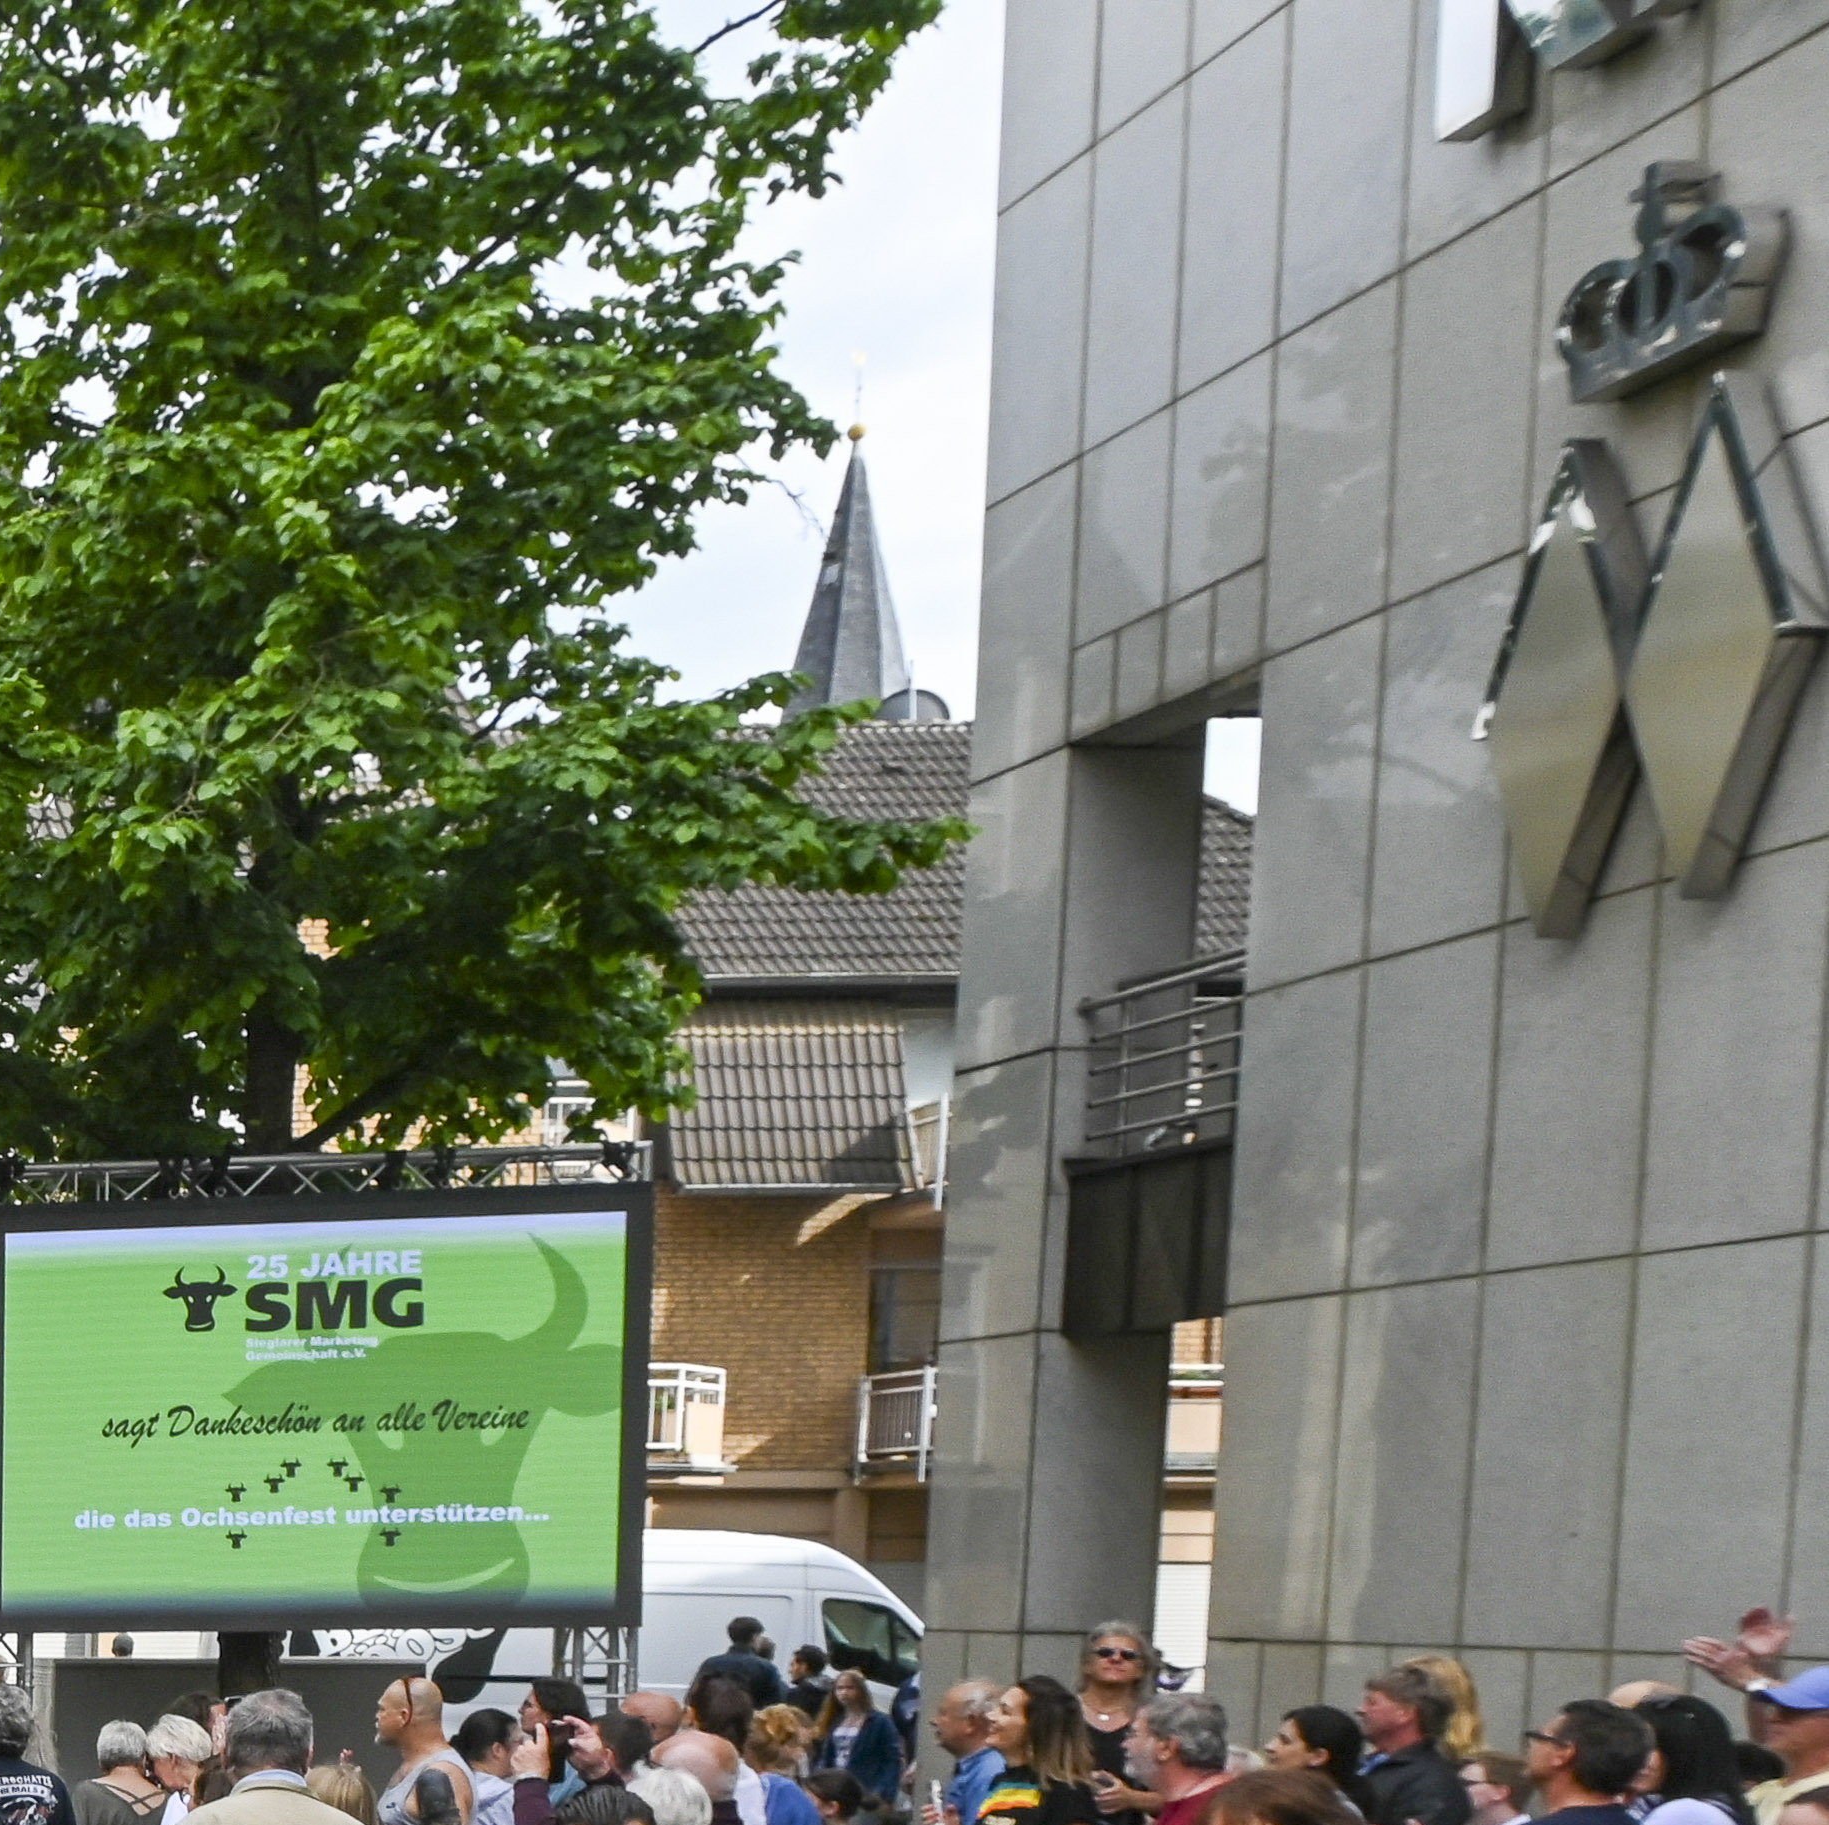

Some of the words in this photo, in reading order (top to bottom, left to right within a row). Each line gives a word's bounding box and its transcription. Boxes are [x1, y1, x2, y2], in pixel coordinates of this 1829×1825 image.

[247, 1254, 289, 1279] 25
[300, 1250, 423, 1277] JAHRE
[245, 1278, 424, 1332] SMG
[245, 1349, 339, 1361] Gemeinschaft
[341, 1348, 367, 1359] e.V.
[310, 1336, 380, 1348] Marketing
[101, 1412, 160, 1449] sagt
[166, 1402, 322, 1438] Dankeschön
[332, 1412, 366, 1433] an
[376, 1402, 428, 1432] alle
[431, 1399, 530, 1433] Vereine
[74, 1509, 116, 1529] die
[124, 1508, 173, 1528] das
[180, 1506, 337, 1527] Ochsenfest
[345, 1503, 550, 1524] unterstützen...
